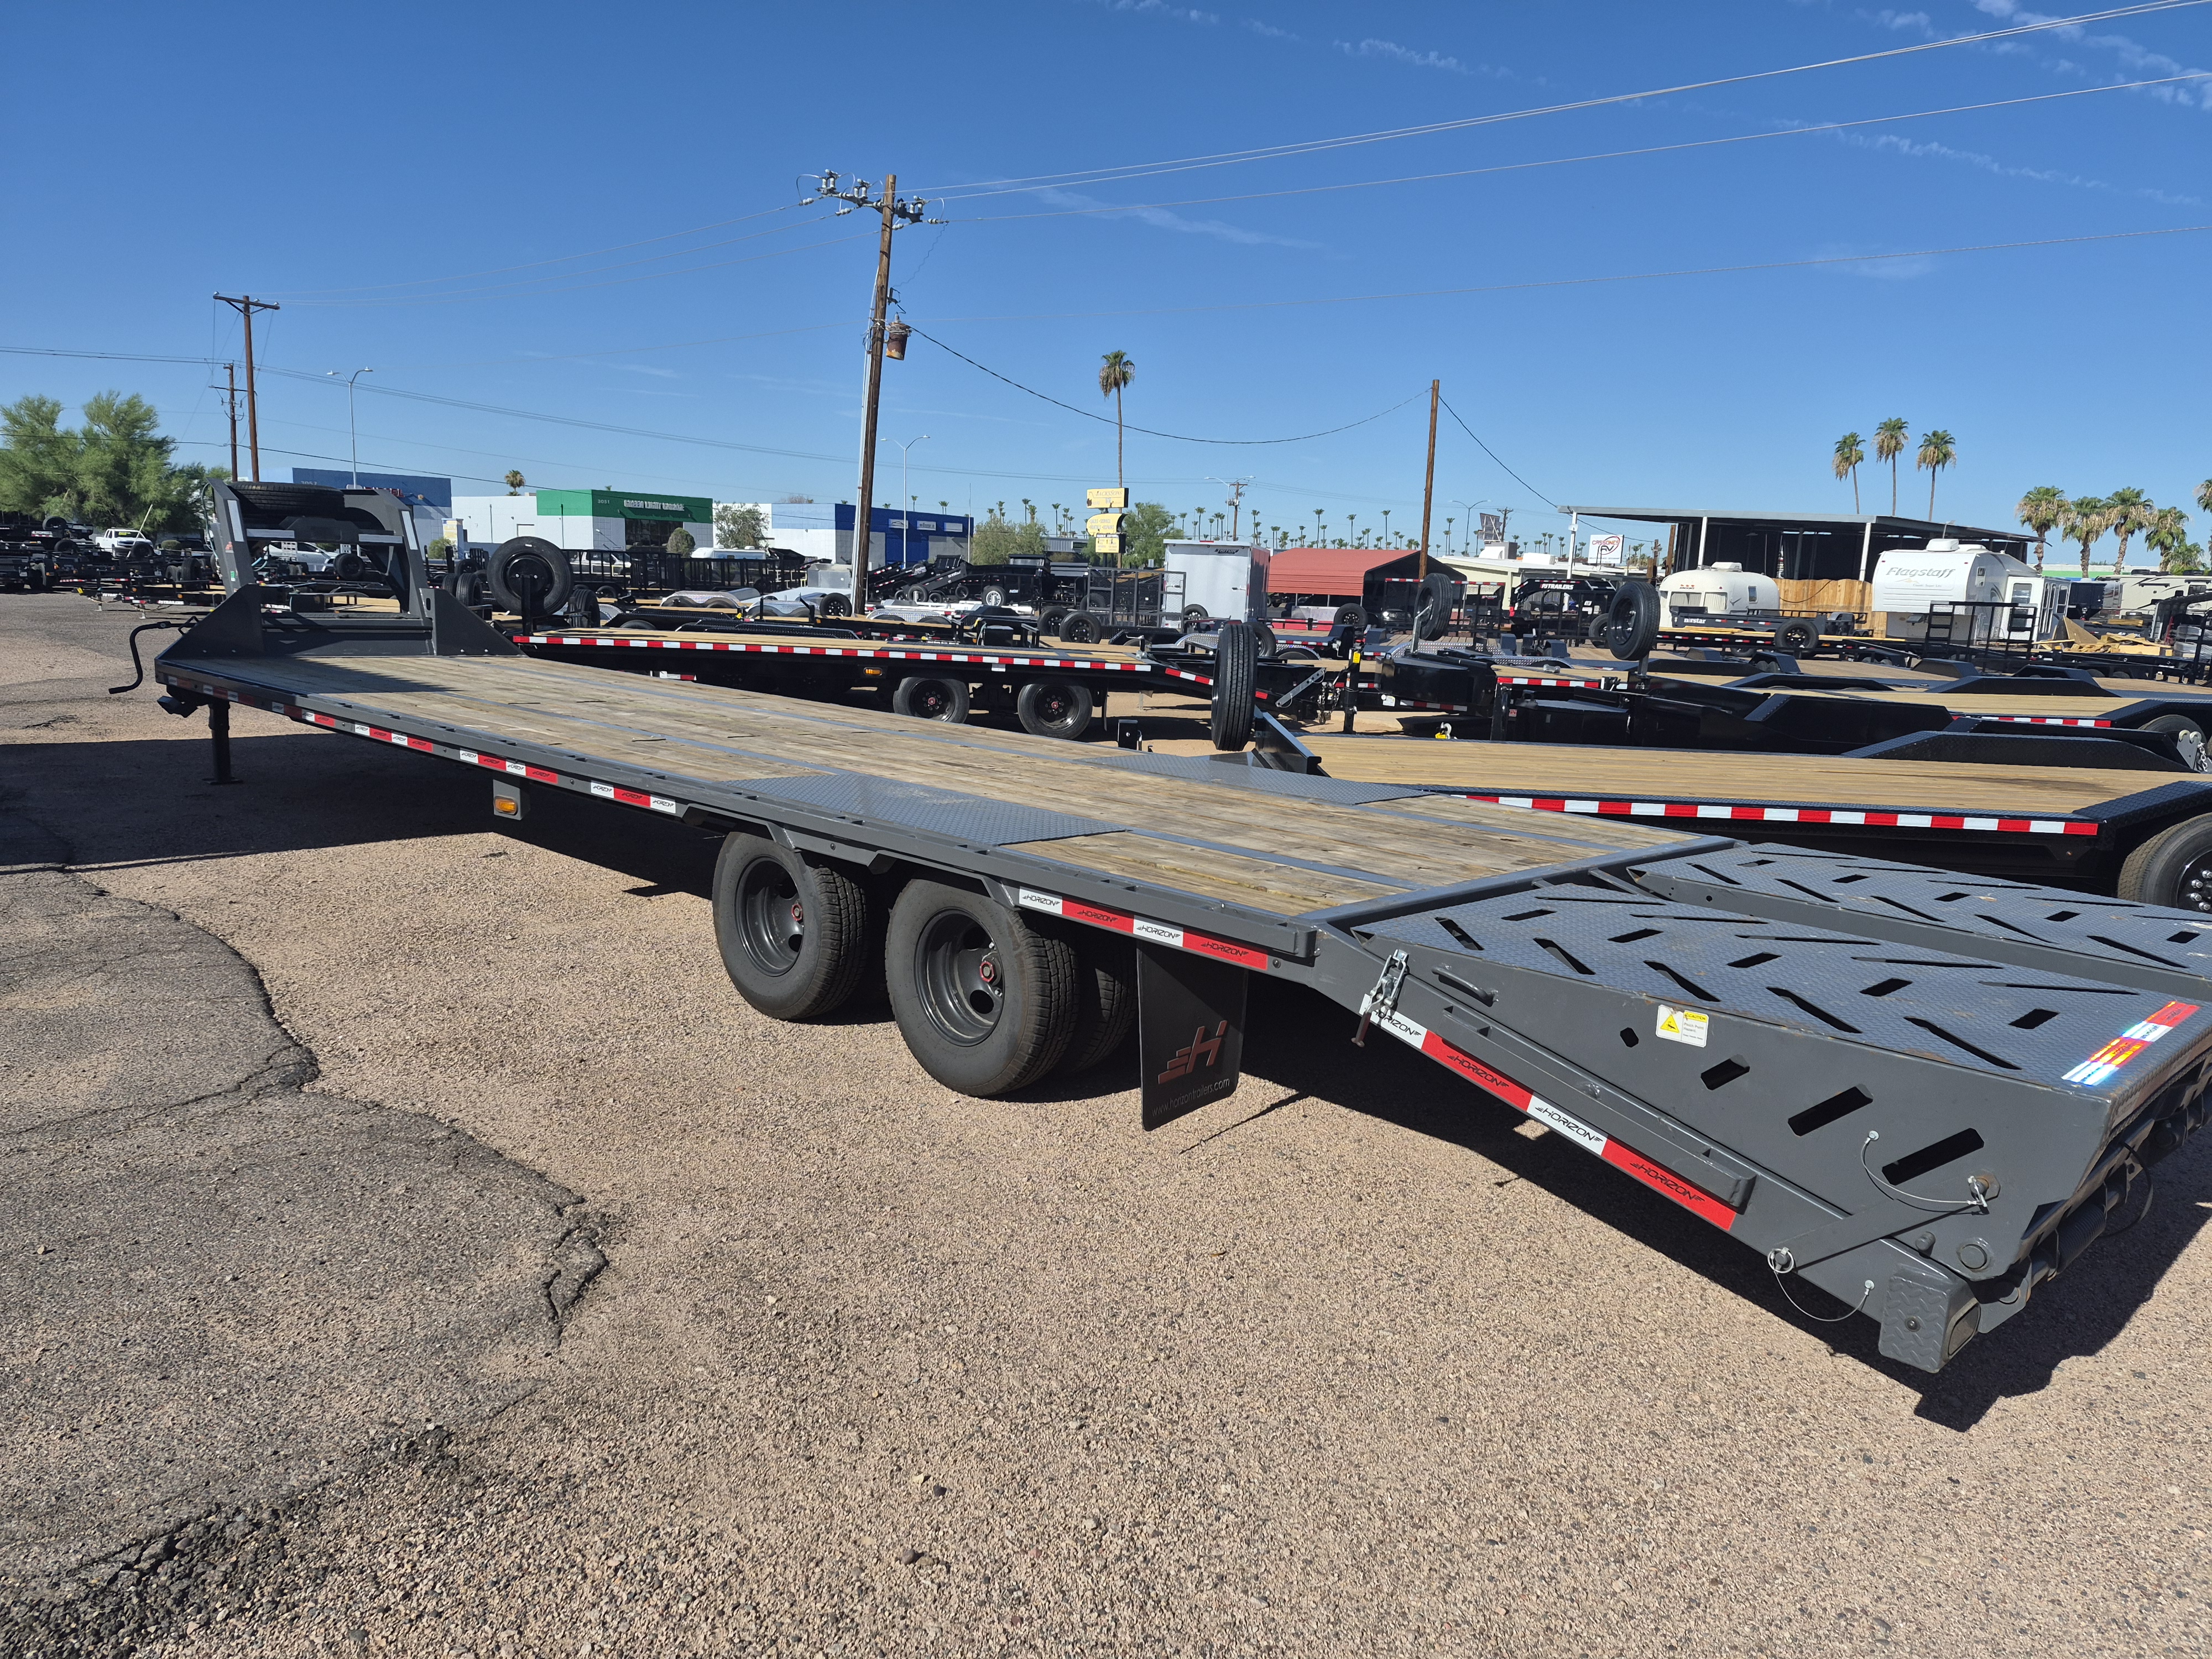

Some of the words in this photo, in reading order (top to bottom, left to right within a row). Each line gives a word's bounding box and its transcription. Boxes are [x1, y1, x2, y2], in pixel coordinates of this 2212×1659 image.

[1886, 567, 1956, 578] Flagstaff
[1026, 894, 1056, 906] HORIZON
[1082, 910, 1113, 922] HORIZON
[1141, 924, 1176, 939] HORIZON
[1206, 941, 1243, 957] HORIZON
[1453, 1055, 1501, 1088] HORIZON
[1151, 1078, 1230, 1117] www.horizontrailers.com
[1542, 1107, 1595, 1142] HORIZON
[1638, 1163, 1696, 1202] HORIZON
